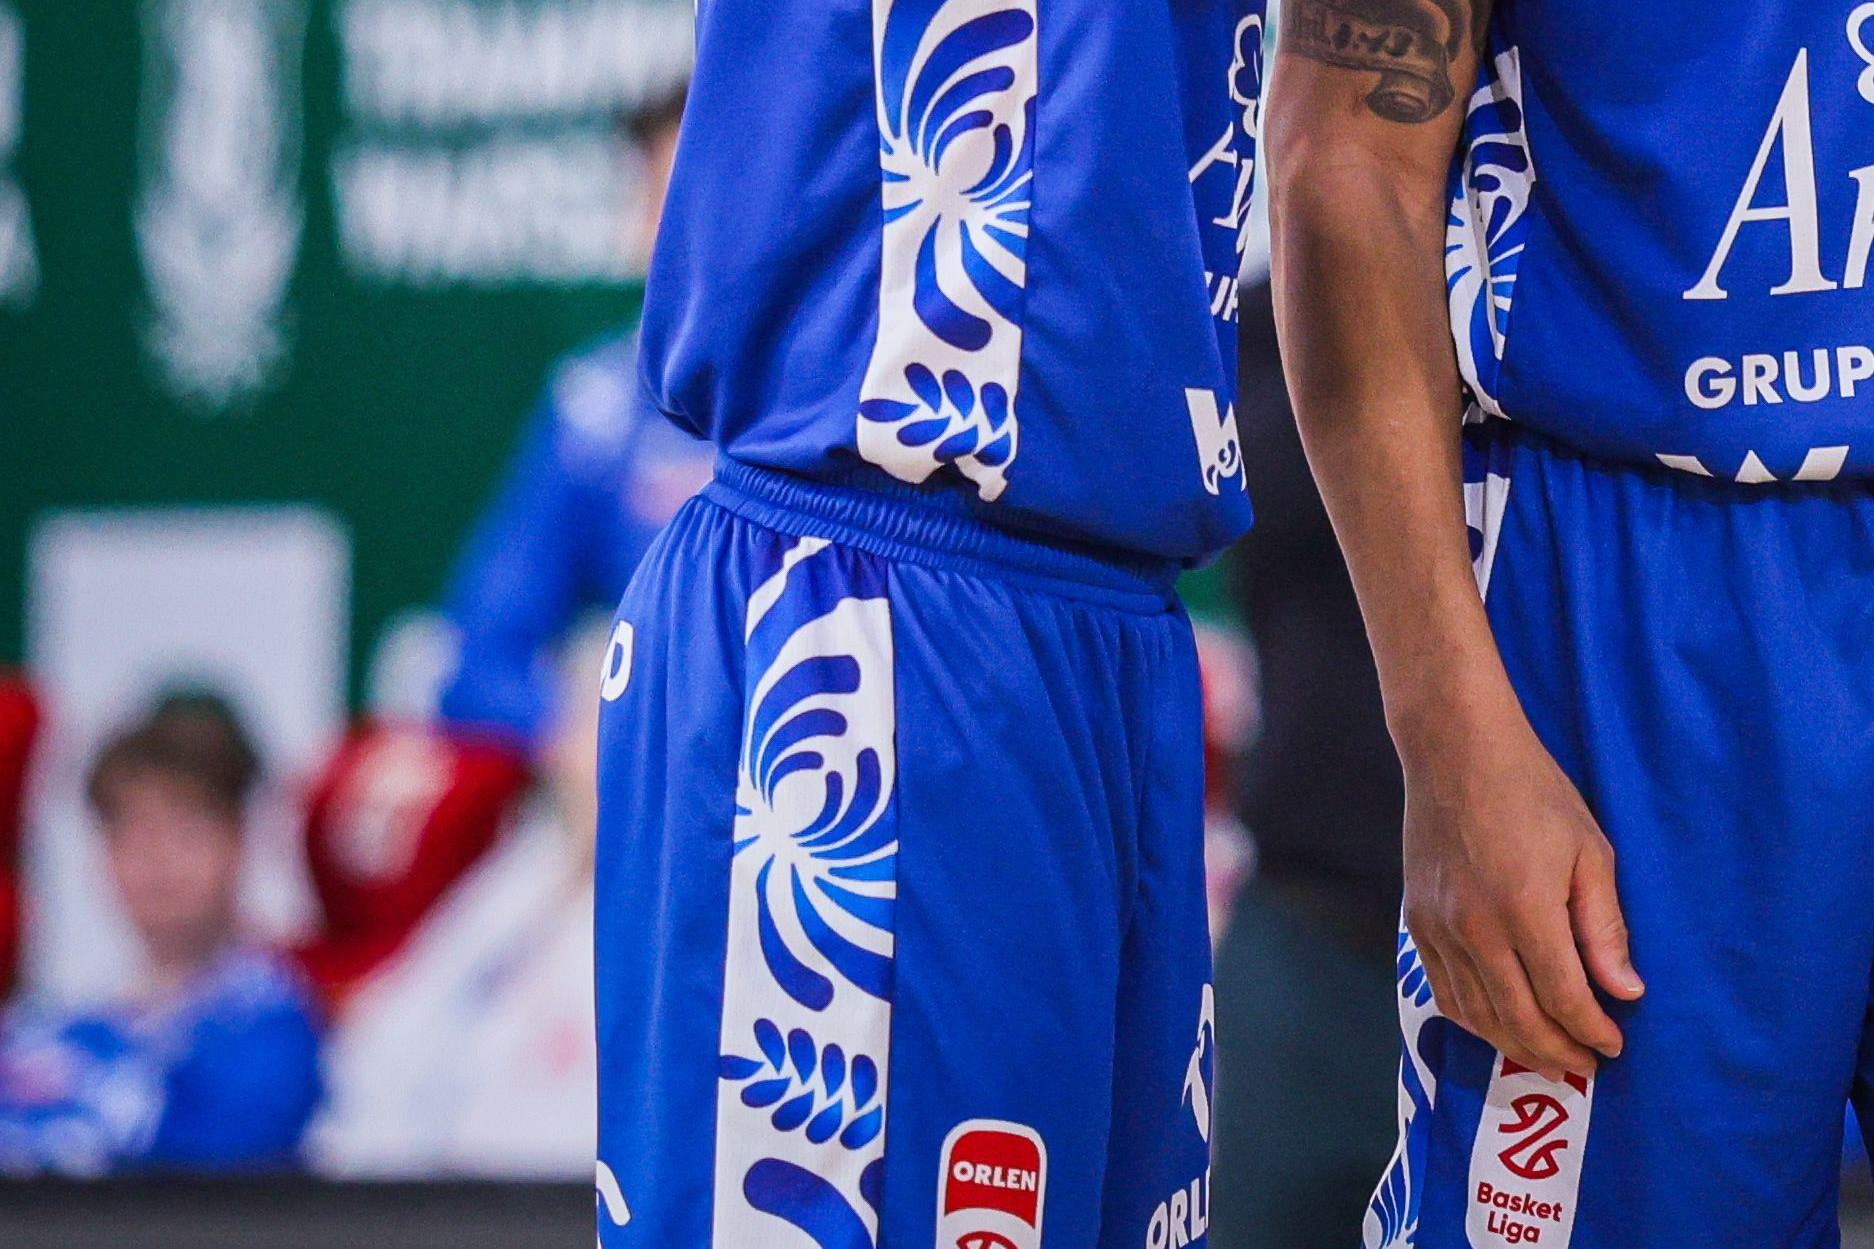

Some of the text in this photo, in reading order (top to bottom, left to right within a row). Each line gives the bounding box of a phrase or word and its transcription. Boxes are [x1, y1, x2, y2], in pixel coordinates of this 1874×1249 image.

[953, 1160, 1037, 1192] ORLEN
[1476, 1182, 1563, 1223] Basket
[1486, 1210, 1541, 1245] Liga
